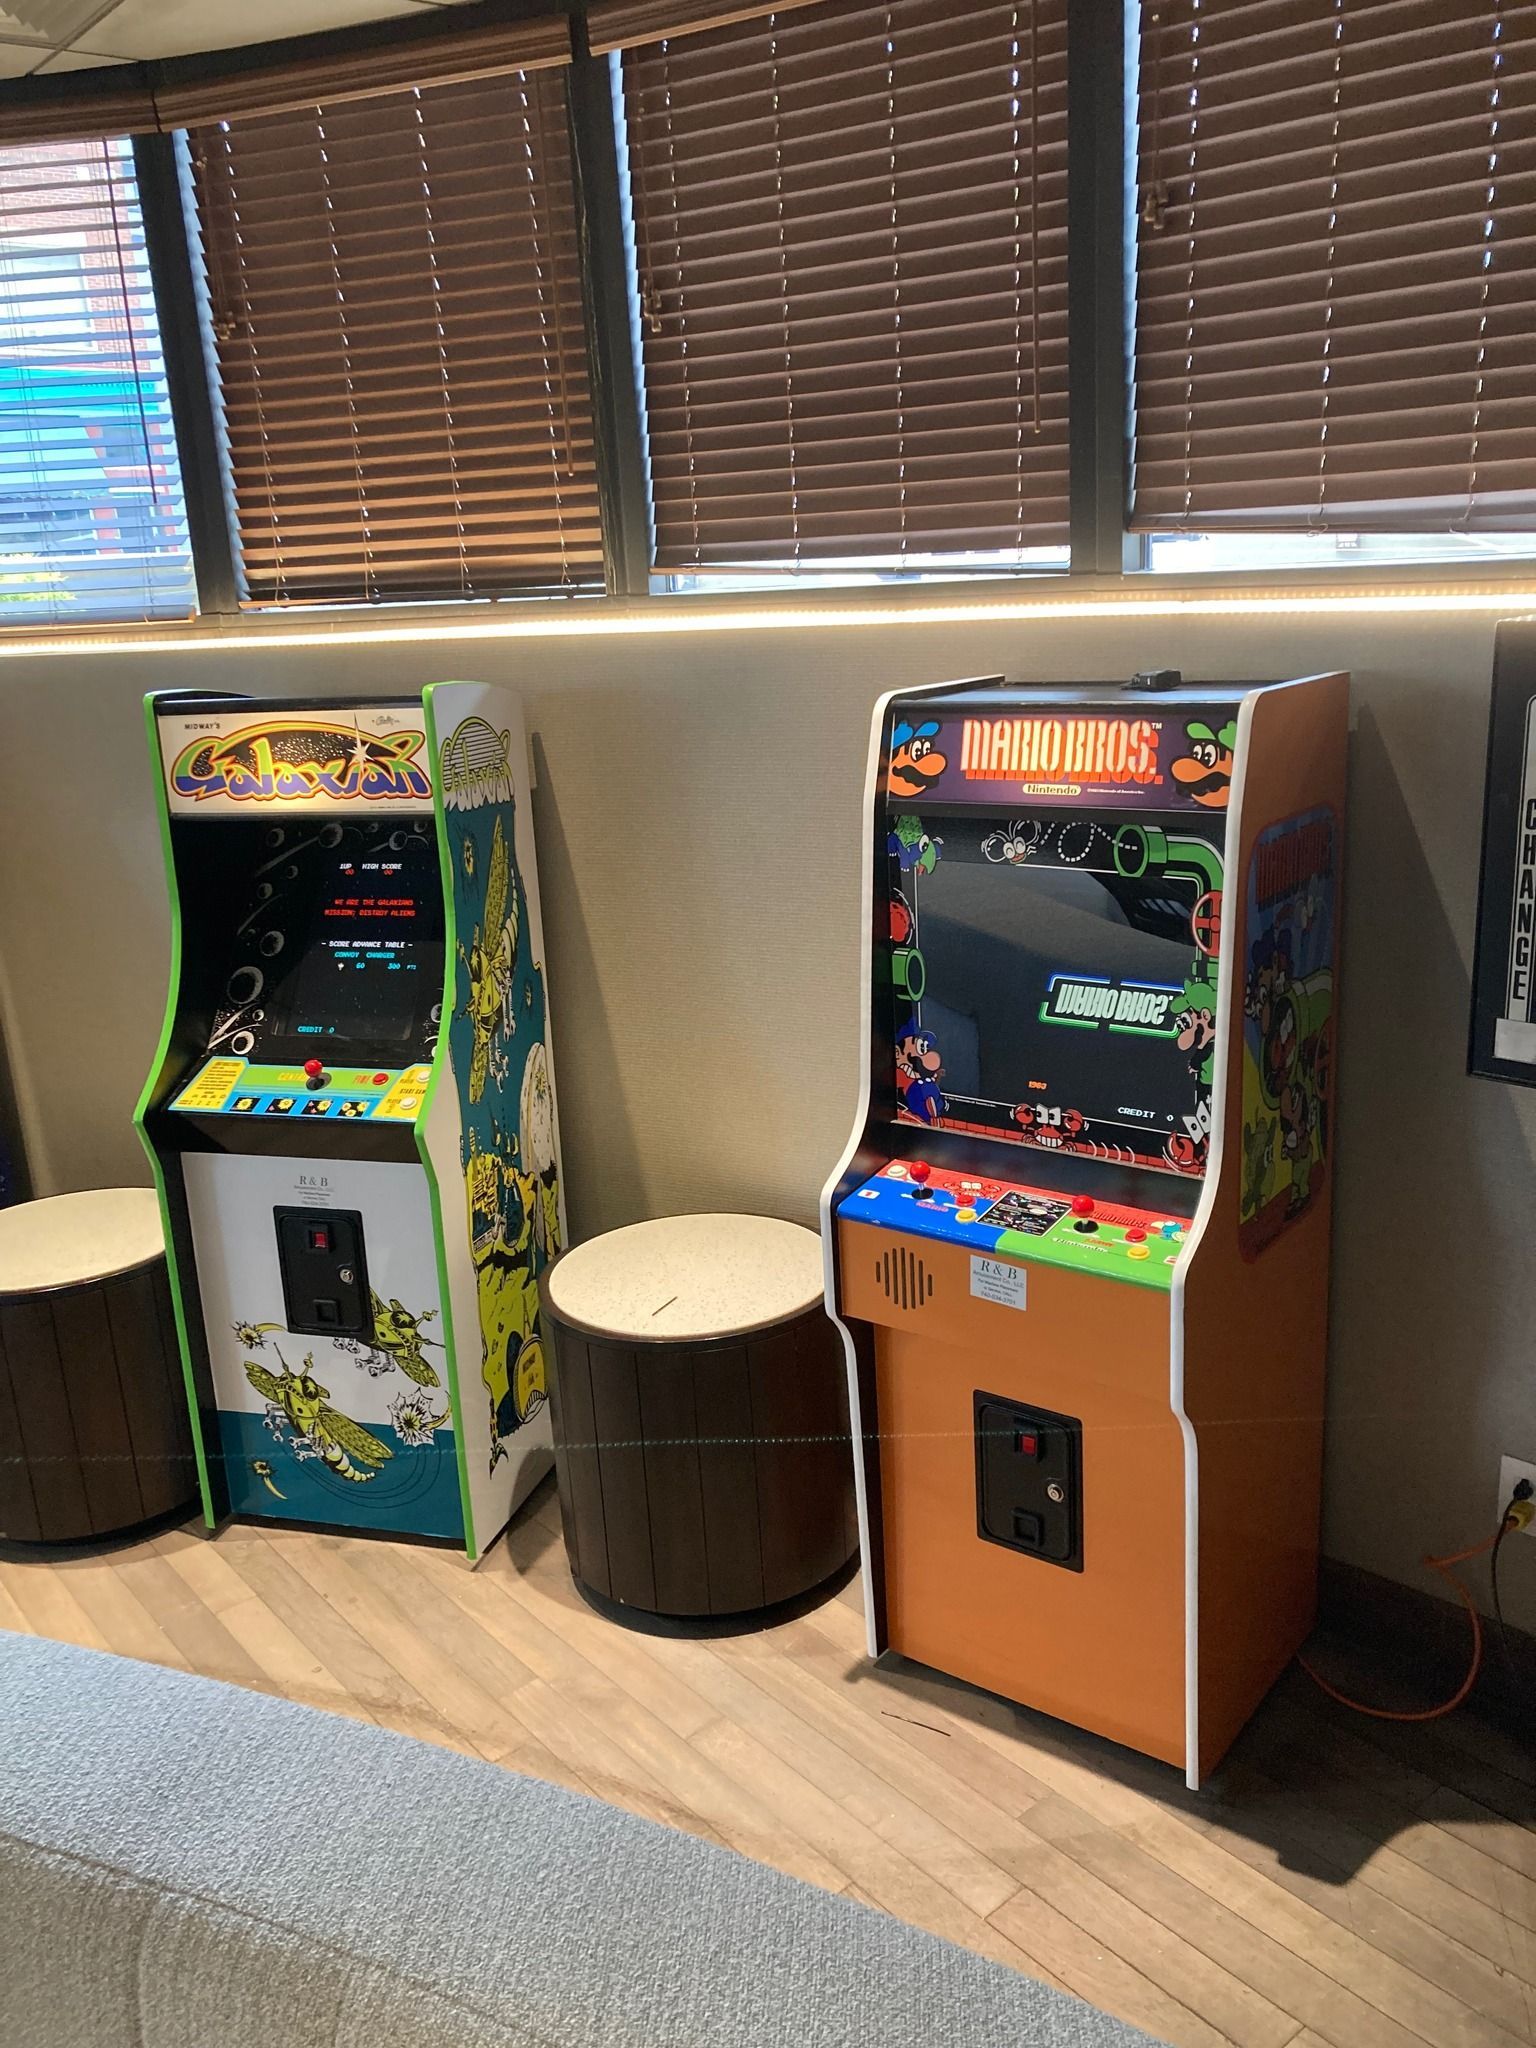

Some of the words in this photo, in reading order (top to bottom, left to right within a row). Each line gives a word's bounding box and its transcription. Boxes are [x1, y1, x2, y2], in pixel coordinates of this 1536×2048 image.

[184, 721, 221, 730] MIDWAY'S
[960, 719, 1066, 782] MARIO
[1064, 719, 1163, 784] BROS.
[171, 719, 433, 801] Galaxian
[1027, 785, 1078, 795] Nintendo
[1512, 798, 1536, 1001] CHANGE
[385, 941, 405, 949] TABLE
[297, 1025, 323, 1034] CREDIT
[1118, 1106, 1156, 1119] CREDIT
[300, 1175, 307, 1185] R
[309, 1176, 317, 1186] &
[320, 1177, 328, 1187] B
[981, 1260, 990, 1273] R
[993, 1264, 1003, 1277] &
[1007, 1267, 1017, 1280] B
